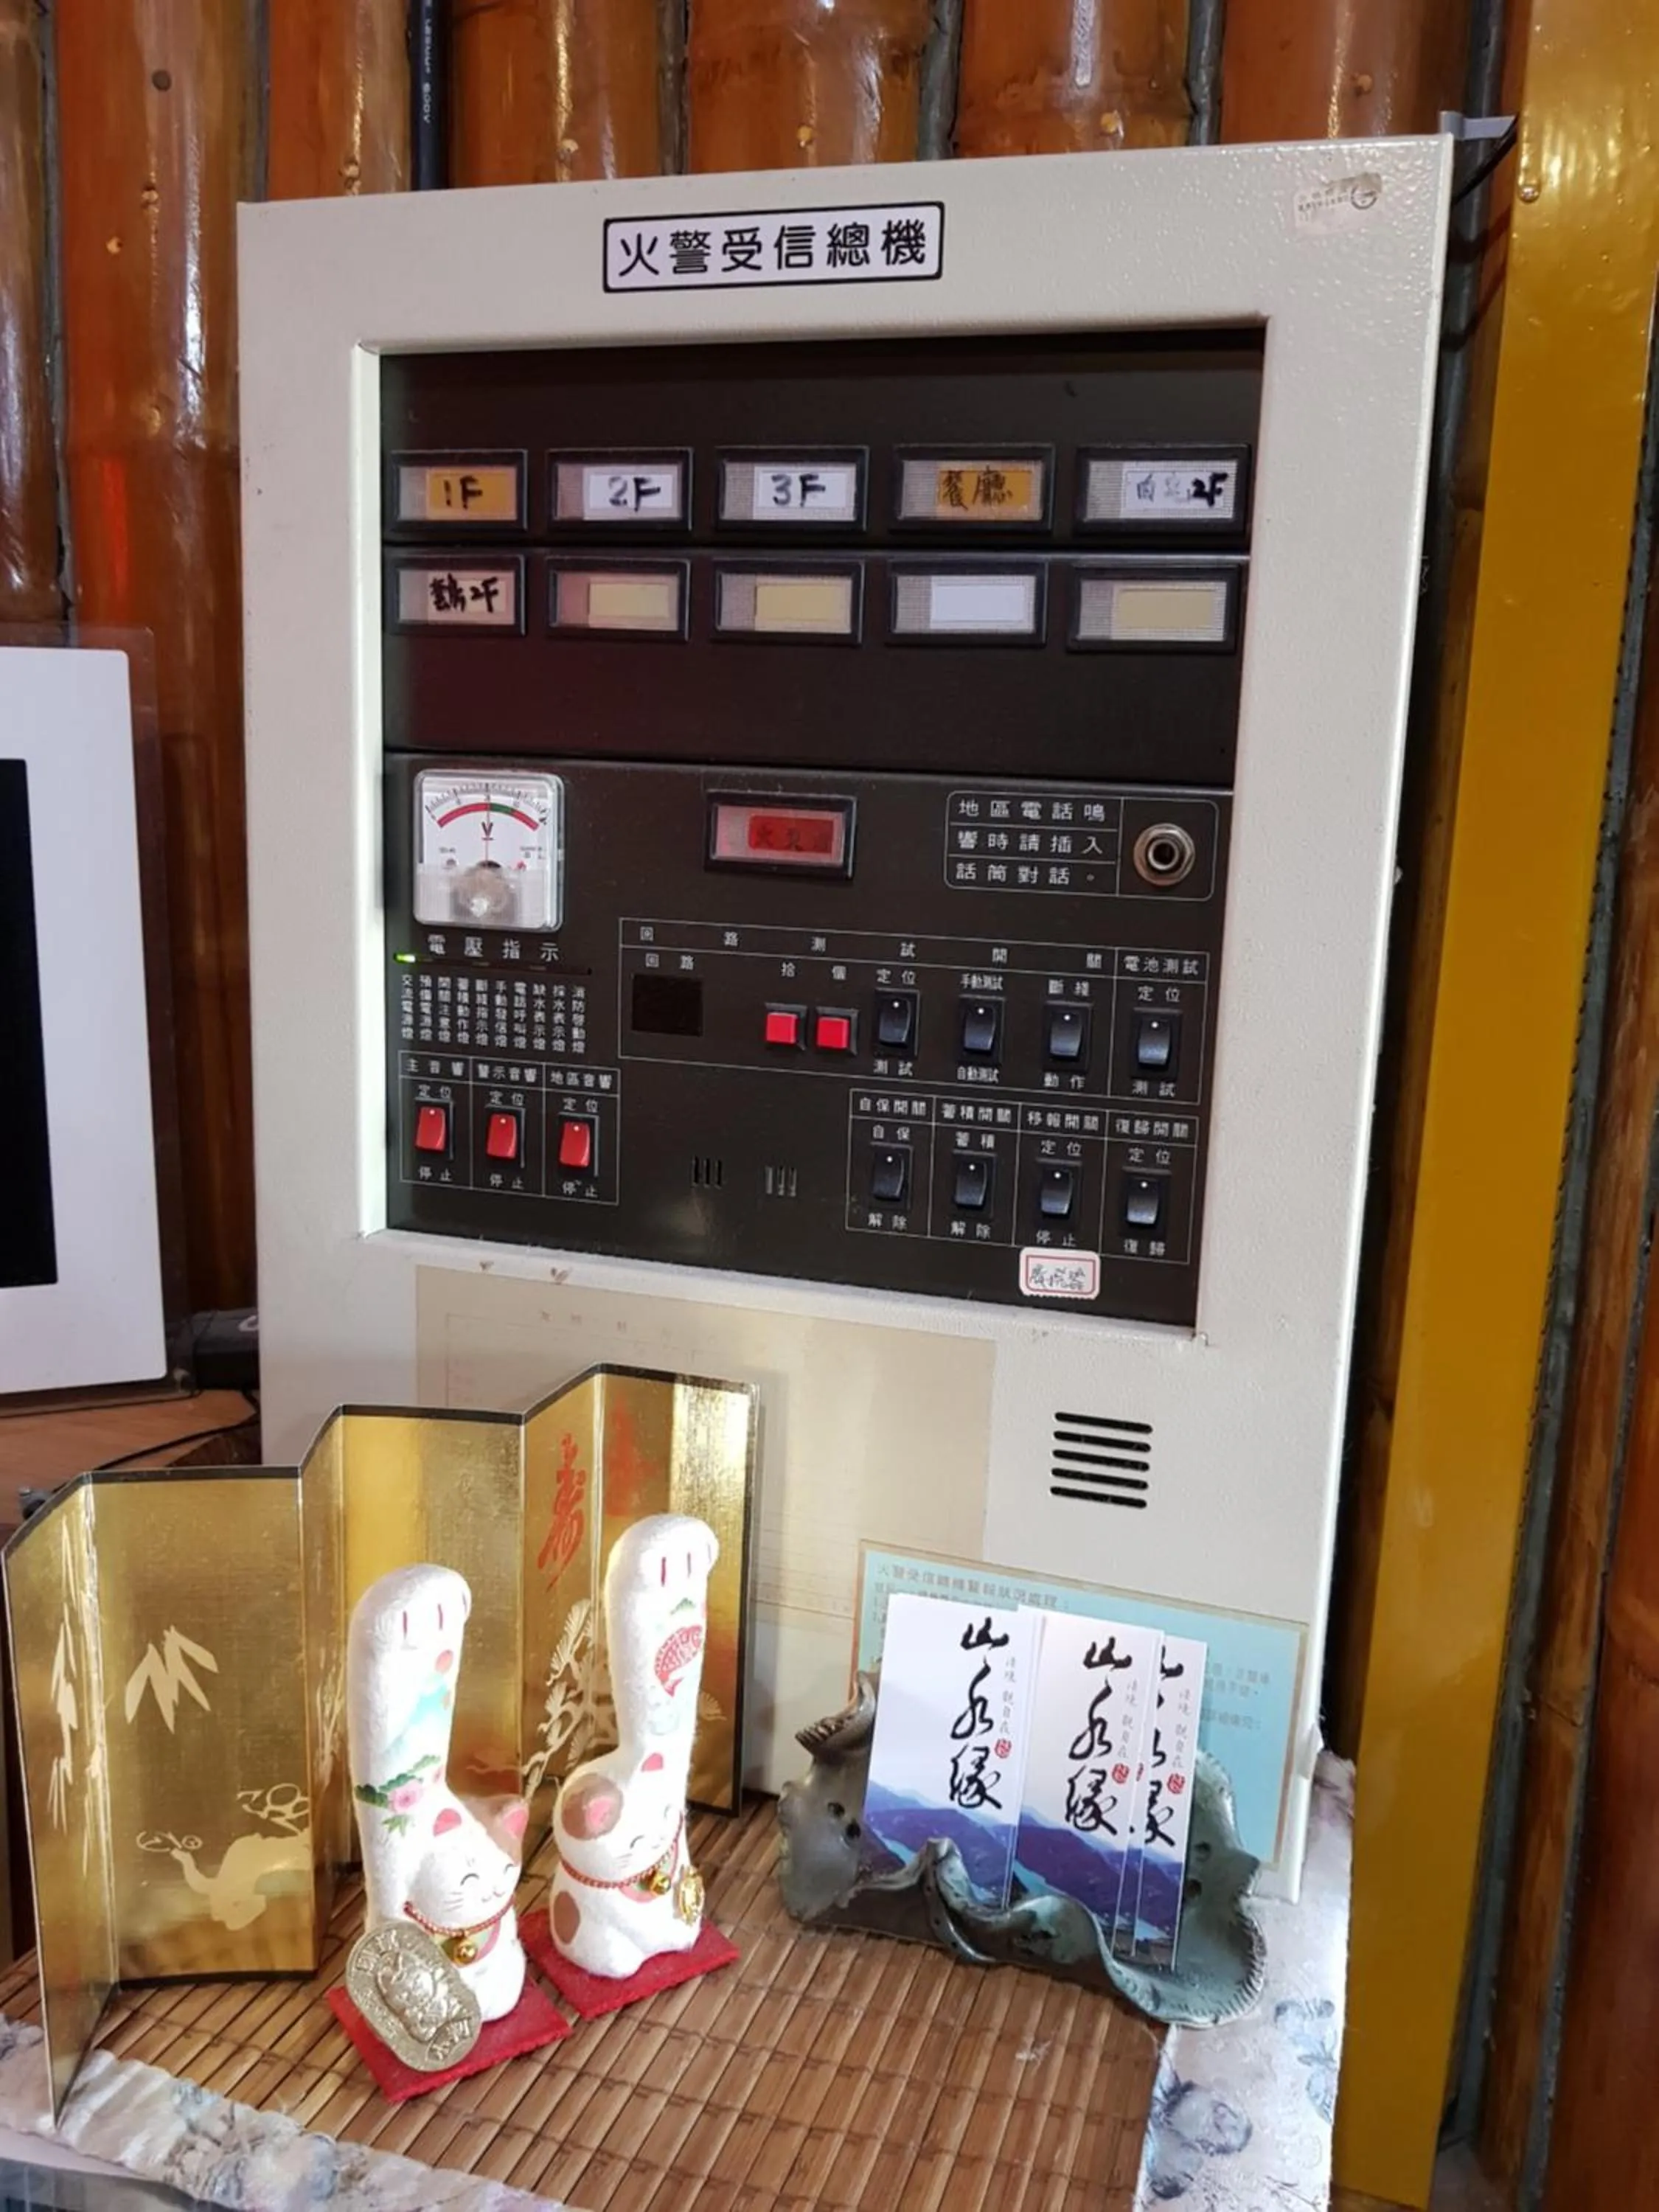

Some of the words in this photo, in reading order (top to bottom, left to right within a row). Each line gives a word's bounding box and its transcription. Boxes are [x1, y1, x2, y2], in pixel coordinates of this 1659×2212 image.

[618, 218, 926, 277] 火警受信總機
[443, 476, 482, 509] 1F
[608, 476, 661, 512] 2F
[772, 473, 825, 511] 3F
[959, 799, 1105, 822] 地區電話鳴
[958, 830, 1102, 855] 響時請插入
[428, 934, 558, 961] 電壓指示
[1124, 956, 1199, 975] 電池測試
[877, 969, 916, 985] 定位
[1138, 986, 1180, 1002] 定位
[406, 1059, 464, 1077] 主音響
[872, 1060, 913, 1077] 測試
[551, 1071, 612, 1089] 地區音響
[1043, 1072, 1085, 1090] 動作
[418, 1085, 452, 1099] 定位
[1133, 1081, 1176, 1097] 測試
[490, 1091, 524, 1106] 定位
[563, 1097, 598, 1113] 定位
[872, 1124, 911, 1141] 自保
[1041, 1140, 1082, 1157] 定位
[1129, 1147, 1170, 1164] 定位
[418, 1166, 452, 1181] 停止
[490, 1174, 524, 1189] 停止
[563, 1181, 597, 1197] 停止
[868, 1213, 907, 1230] 解除
[950, 1221, 991, 1239] 解除
[1036, 1231, 1077, 1248] 停止
